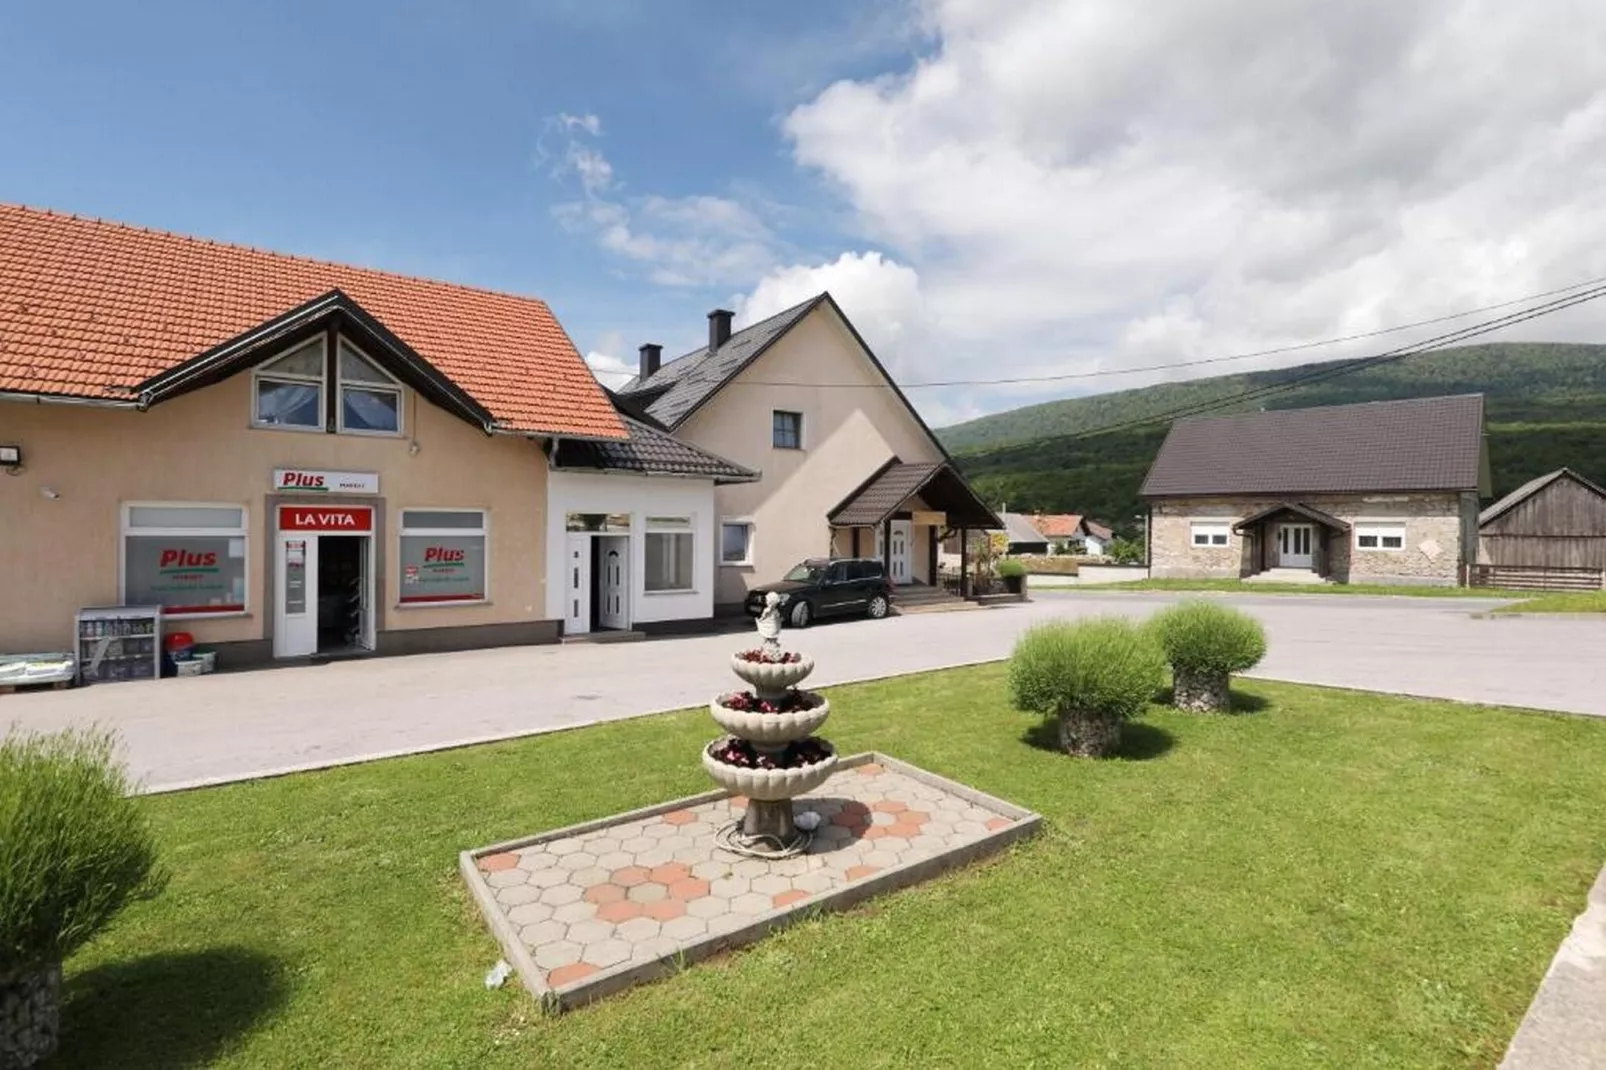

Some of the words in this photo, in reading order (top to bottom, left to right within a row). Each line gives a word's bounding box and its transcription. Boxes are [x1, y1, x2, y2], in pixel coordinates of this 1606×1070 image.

[282, 472, 325, 487] Plus
[295, 513, 316, 526] LA
[318, 513, 356, 526] VITA
[159, 548, 218, 569] Plus
[423, 546, 465, 562] Plus
